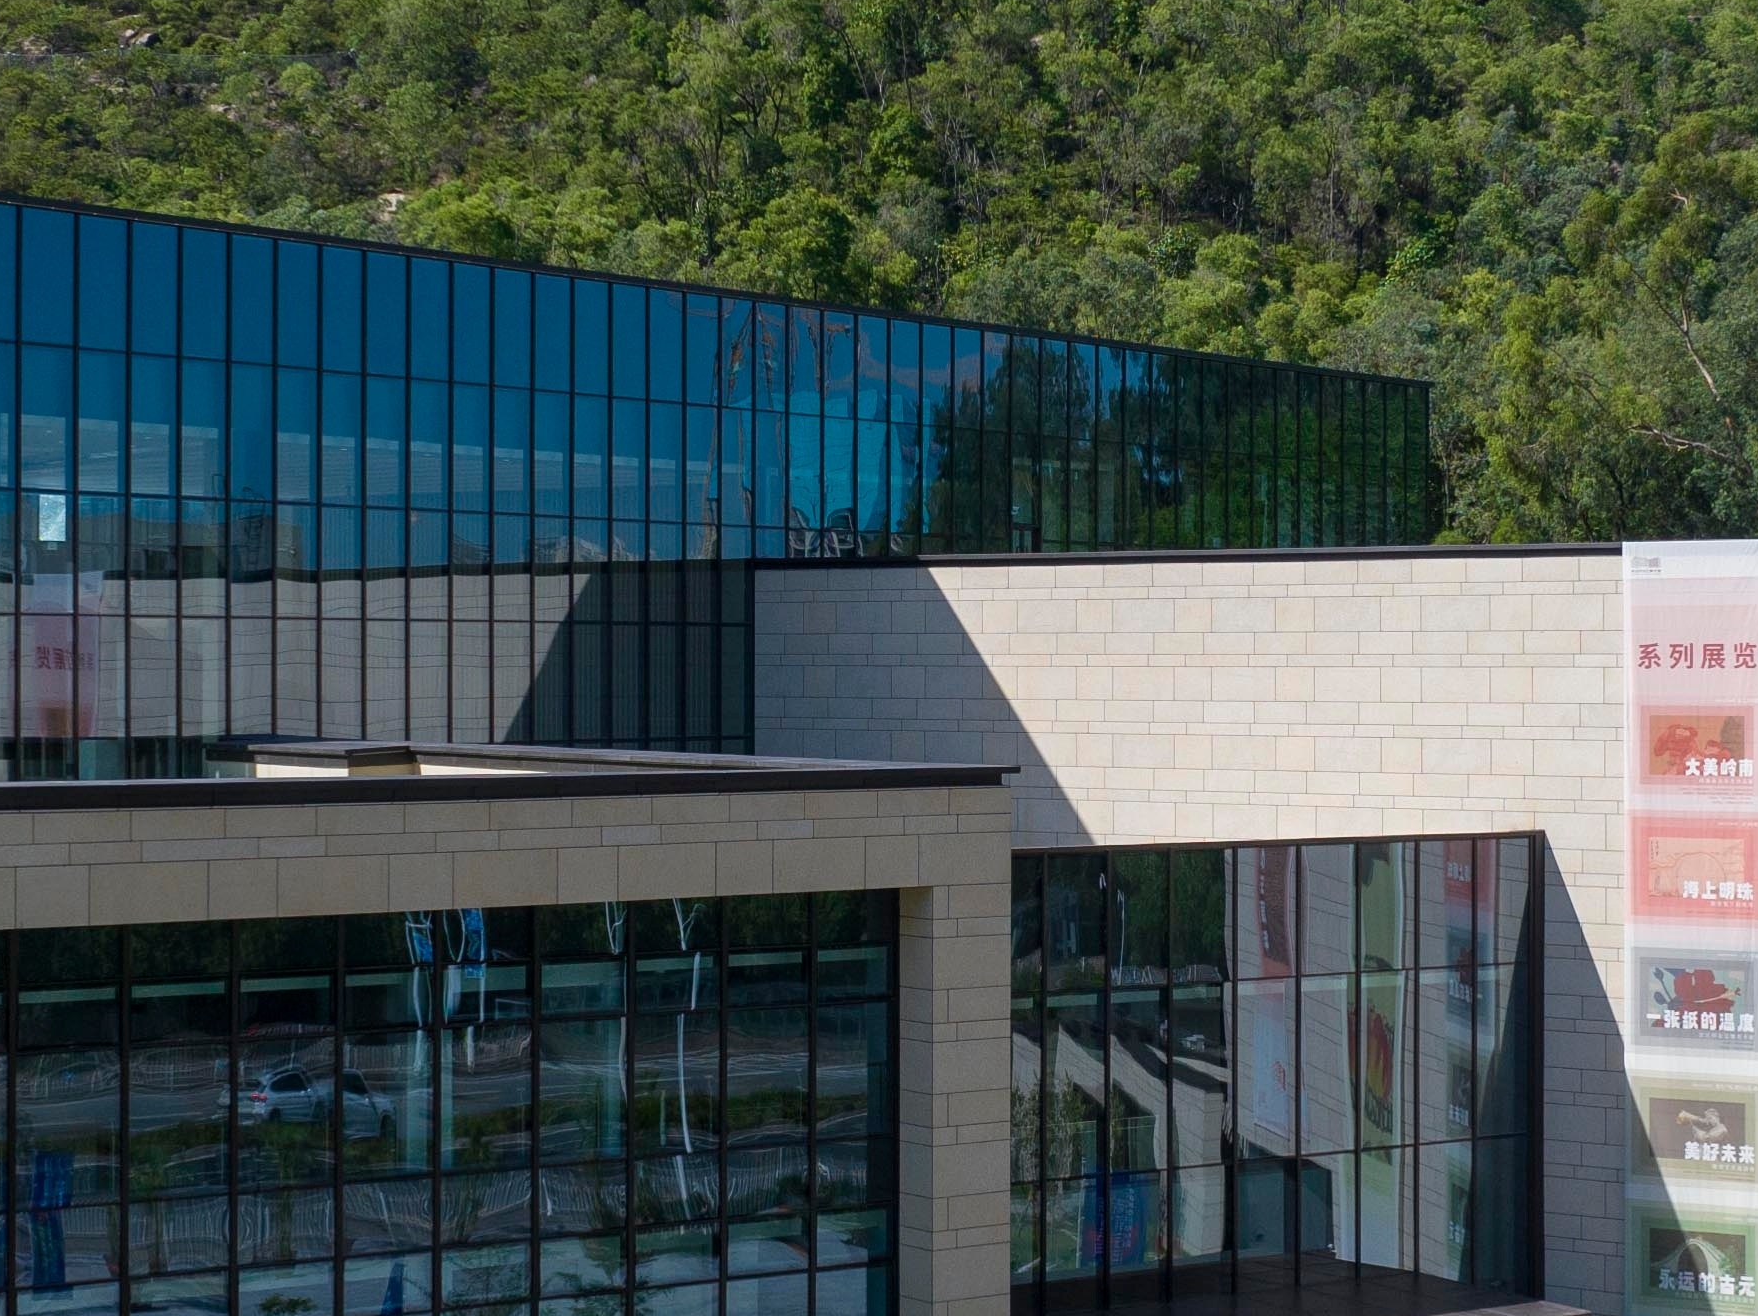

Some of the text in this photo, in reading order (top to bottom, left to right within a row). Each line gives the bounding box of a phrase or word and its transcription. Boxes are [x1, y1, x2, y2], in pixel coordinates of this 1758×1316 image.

[1638, 642, 1757, 670] 系列展览
[1684, 757, 1754, 778] 大美岭南
[1682, 880, 1754, 901] 海上明珠
[1646, 1009, 1755, 1033] 一张纸的温度
[1683, 1140, 1755, 1164] 美好未来
[1658, 1268, 1755, 1297] 永远的古元
